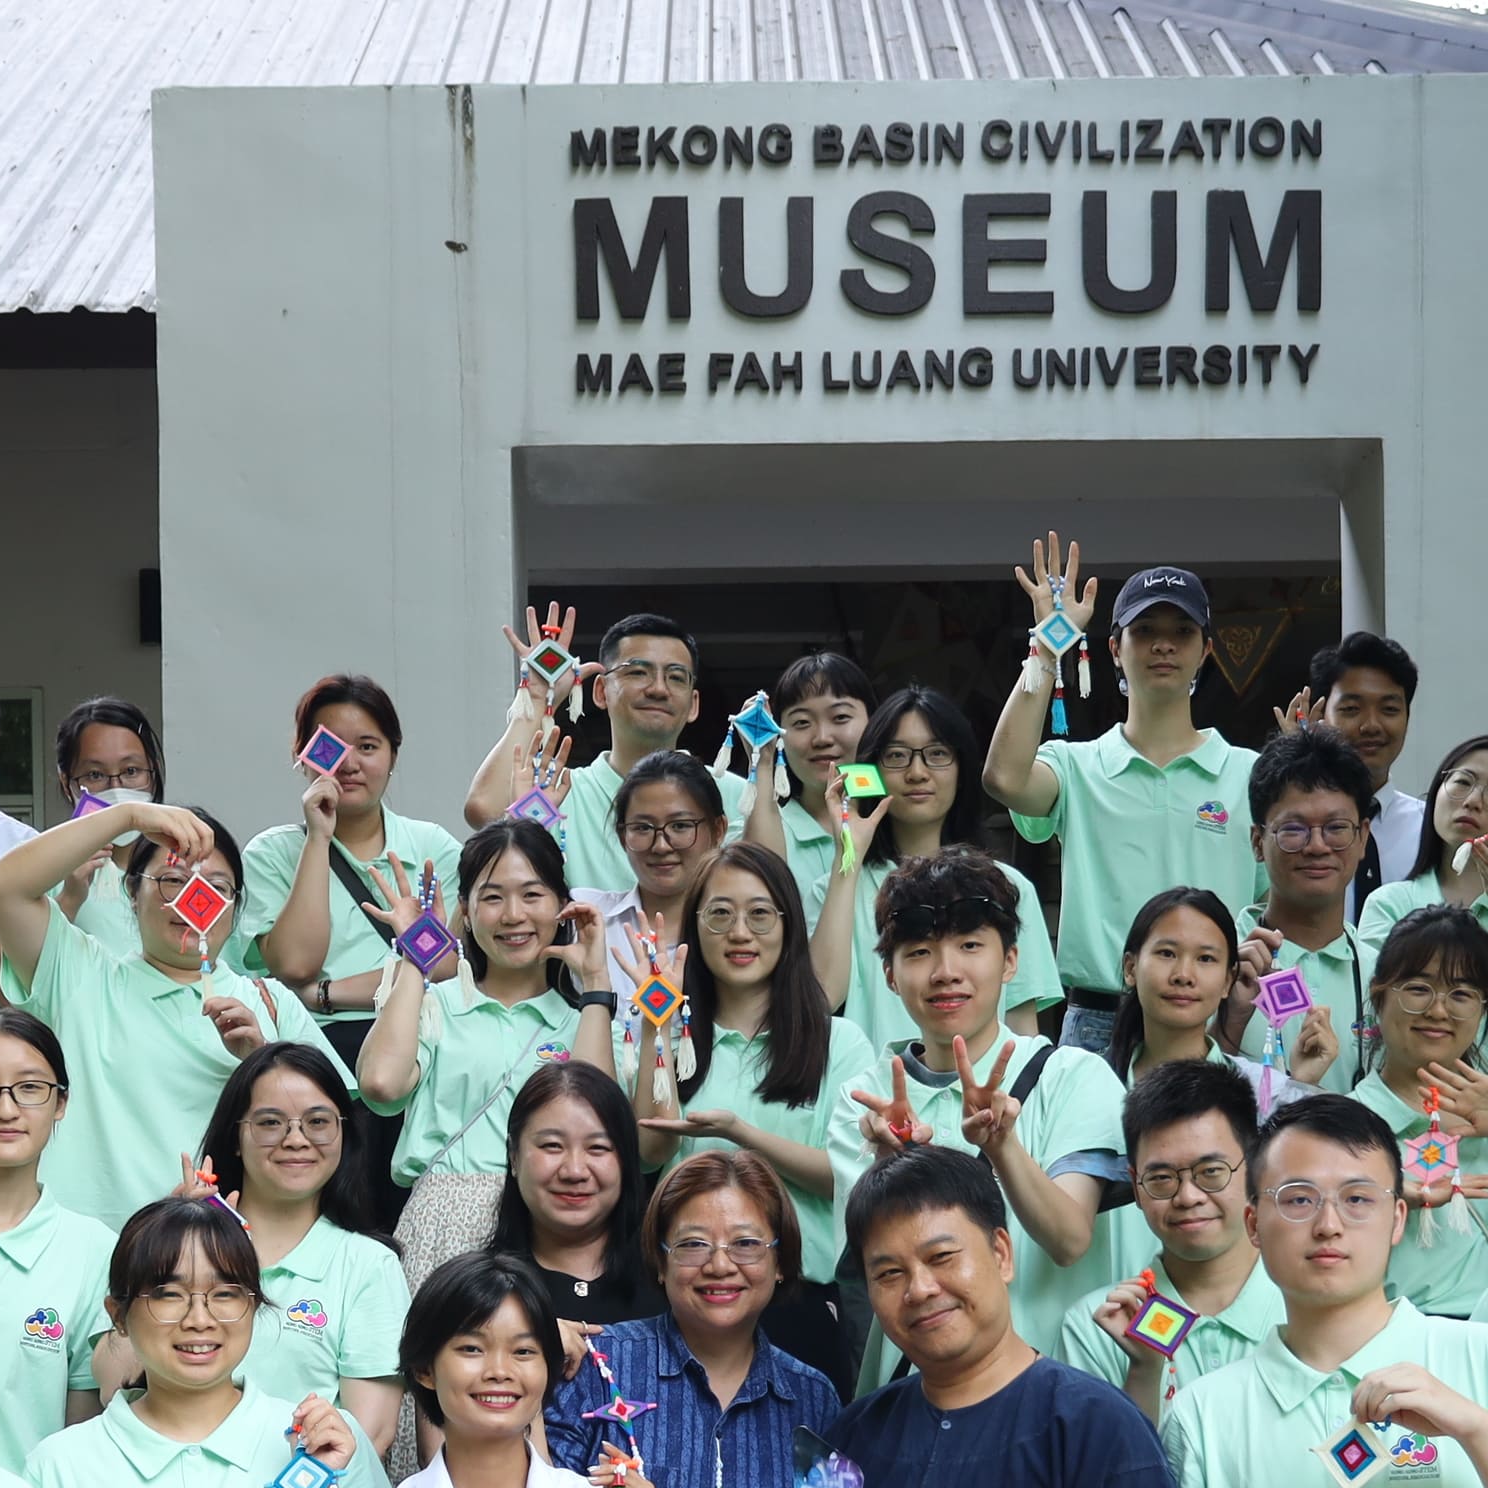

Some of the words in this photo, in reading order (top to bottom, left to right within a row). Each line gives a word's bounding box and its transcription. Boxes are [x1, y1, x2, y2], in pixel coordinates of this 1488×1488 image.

[569, 124, 793, 169] MEKONG
[813, 121, 965, 166] BASIN
[981, 117, 1323, 161] CIVILIZATION
[573, 189, 1323, 321] MUSEUM
[576, 352, 687, 394] MAE
[707, 350, 803, 393] FAH
[822, 347, 994, 390] LUANG
[1011, 344, 1320, 388] UNIVERSITY
